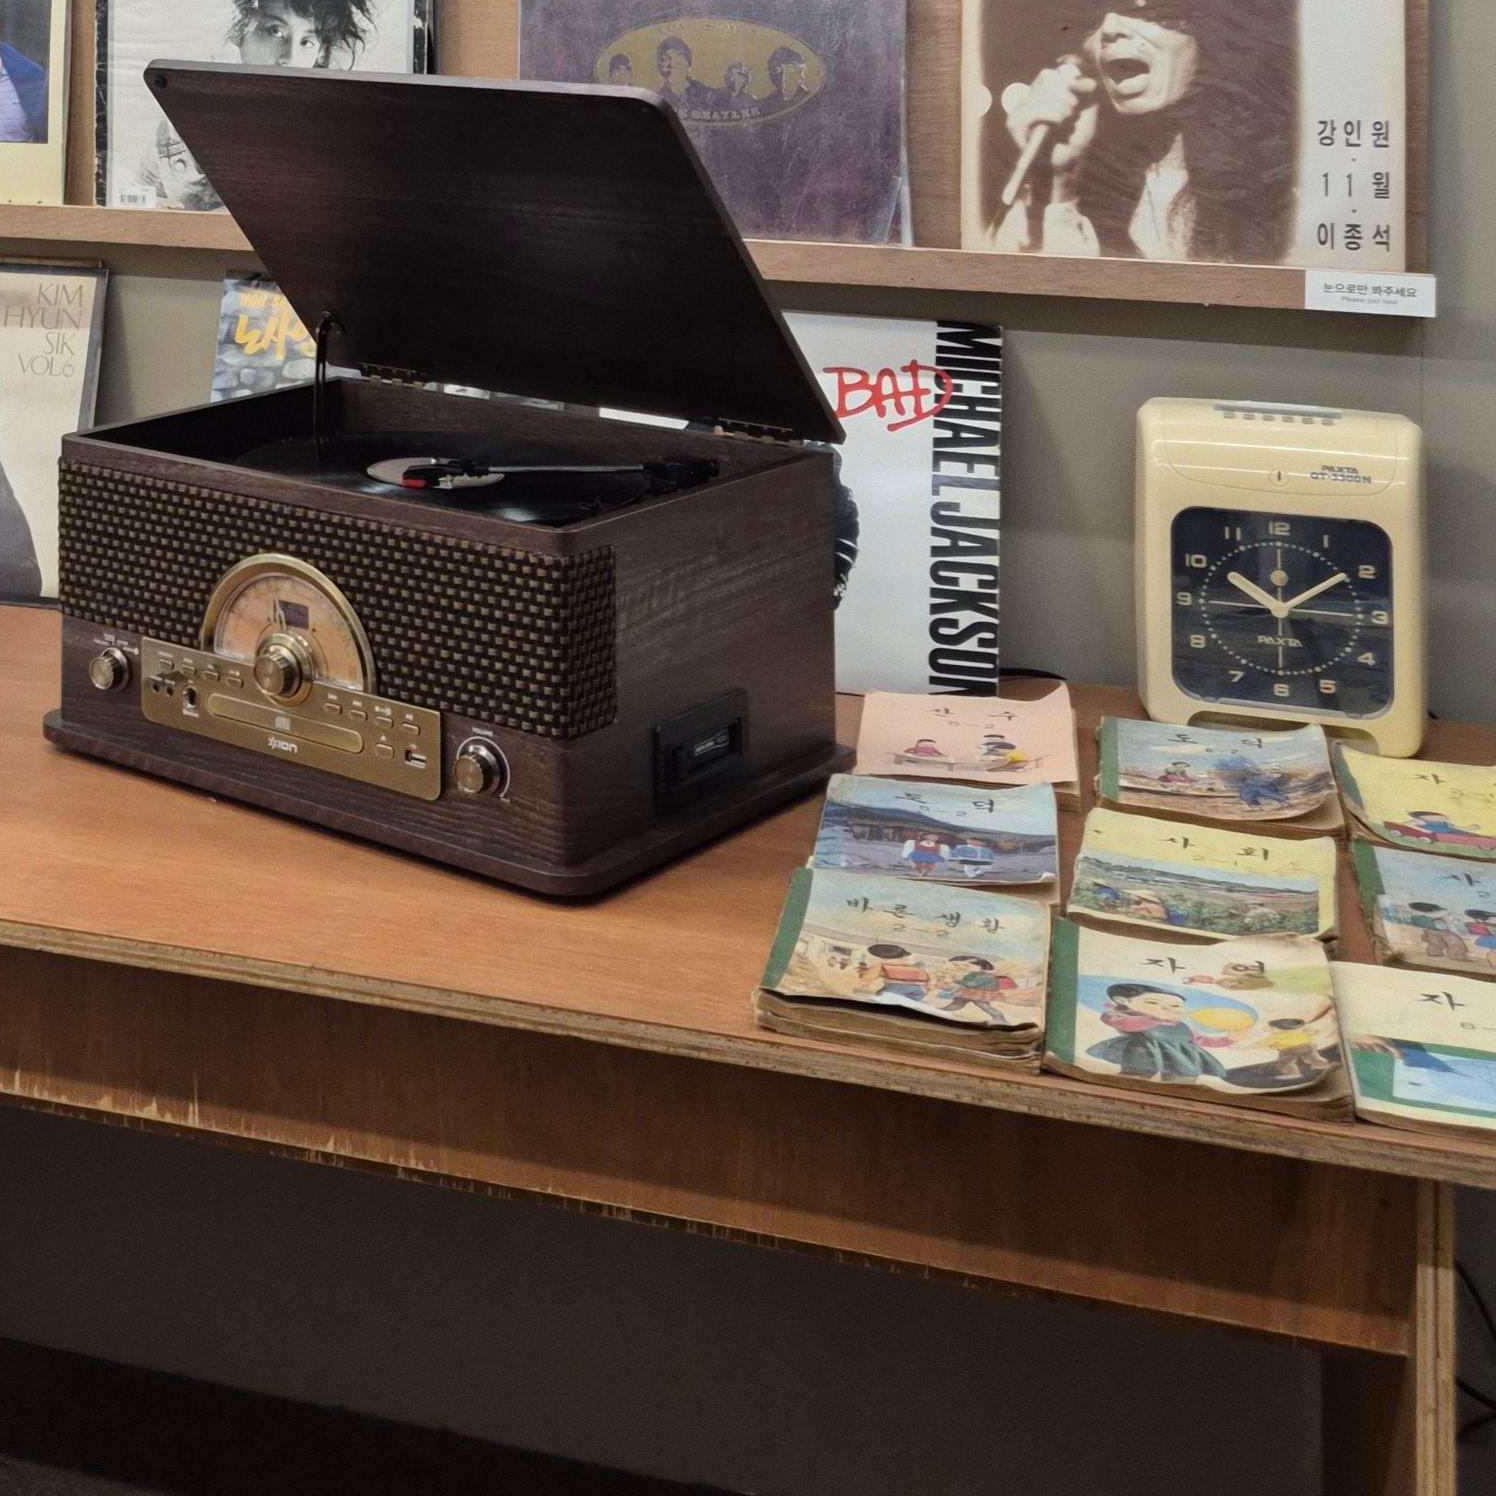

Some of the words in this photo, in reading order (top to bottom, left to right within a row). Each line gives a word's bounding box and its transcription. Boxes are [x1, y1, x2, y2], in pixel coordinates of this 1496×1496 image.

[1317, 118, 1391, 149] 강인원
[1317, 222, 1392, 253] 이종석
[37, 283, 85, 306] KIM
[1324, 282, 1367, 295] 눈으로만
[3, 306, 82, 330] HYUN
[44, 332, 76, 356] SIK
[822, 359, 954, 432] BAD
[931, 321, 1002, 495] MICHAEL
[1224, 525, 1241, 540] 11
[1268, 521, 1290, 536] 12
[1323, 535, 1328, 549] 1
[1185, 553, 1206, 568] 10
[1358, 565, 1375, 579] 2
[1176, 592, 1192, 606] 9
[1371, 611, 1389, 626] 3
[1191, 634, 1205, 649] 8
[1258, 635, 1303, 648] PAXTA
[1358, 652, 1375, 665] 4
[1229, 671, 1244, 683] 7
[1274, 683, 1290, 697] 6
[1319, 680, 1336, 694] 5
